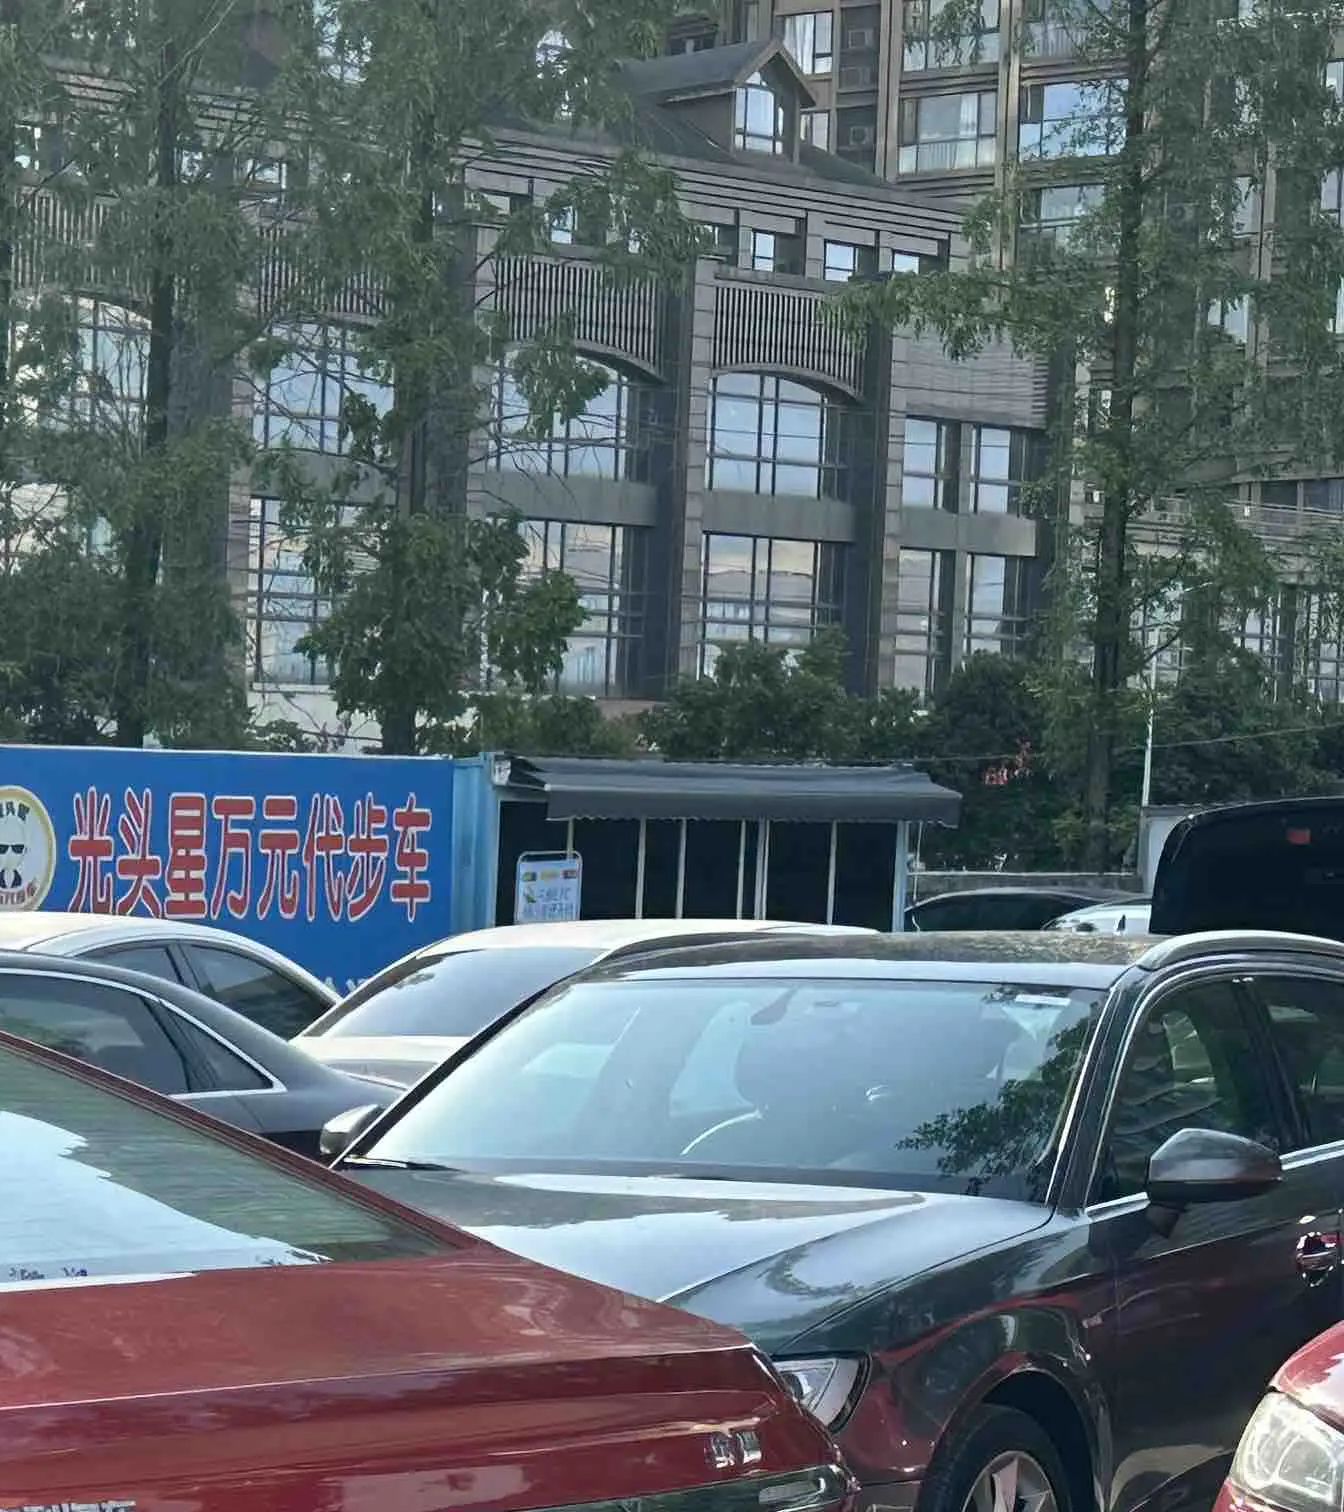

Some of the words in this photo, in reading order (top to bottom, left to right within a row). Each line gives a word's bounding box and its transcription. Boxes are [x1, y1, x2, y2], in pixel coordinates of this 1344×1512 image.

[67, 785, 433, 922] 光头星万元代步车
